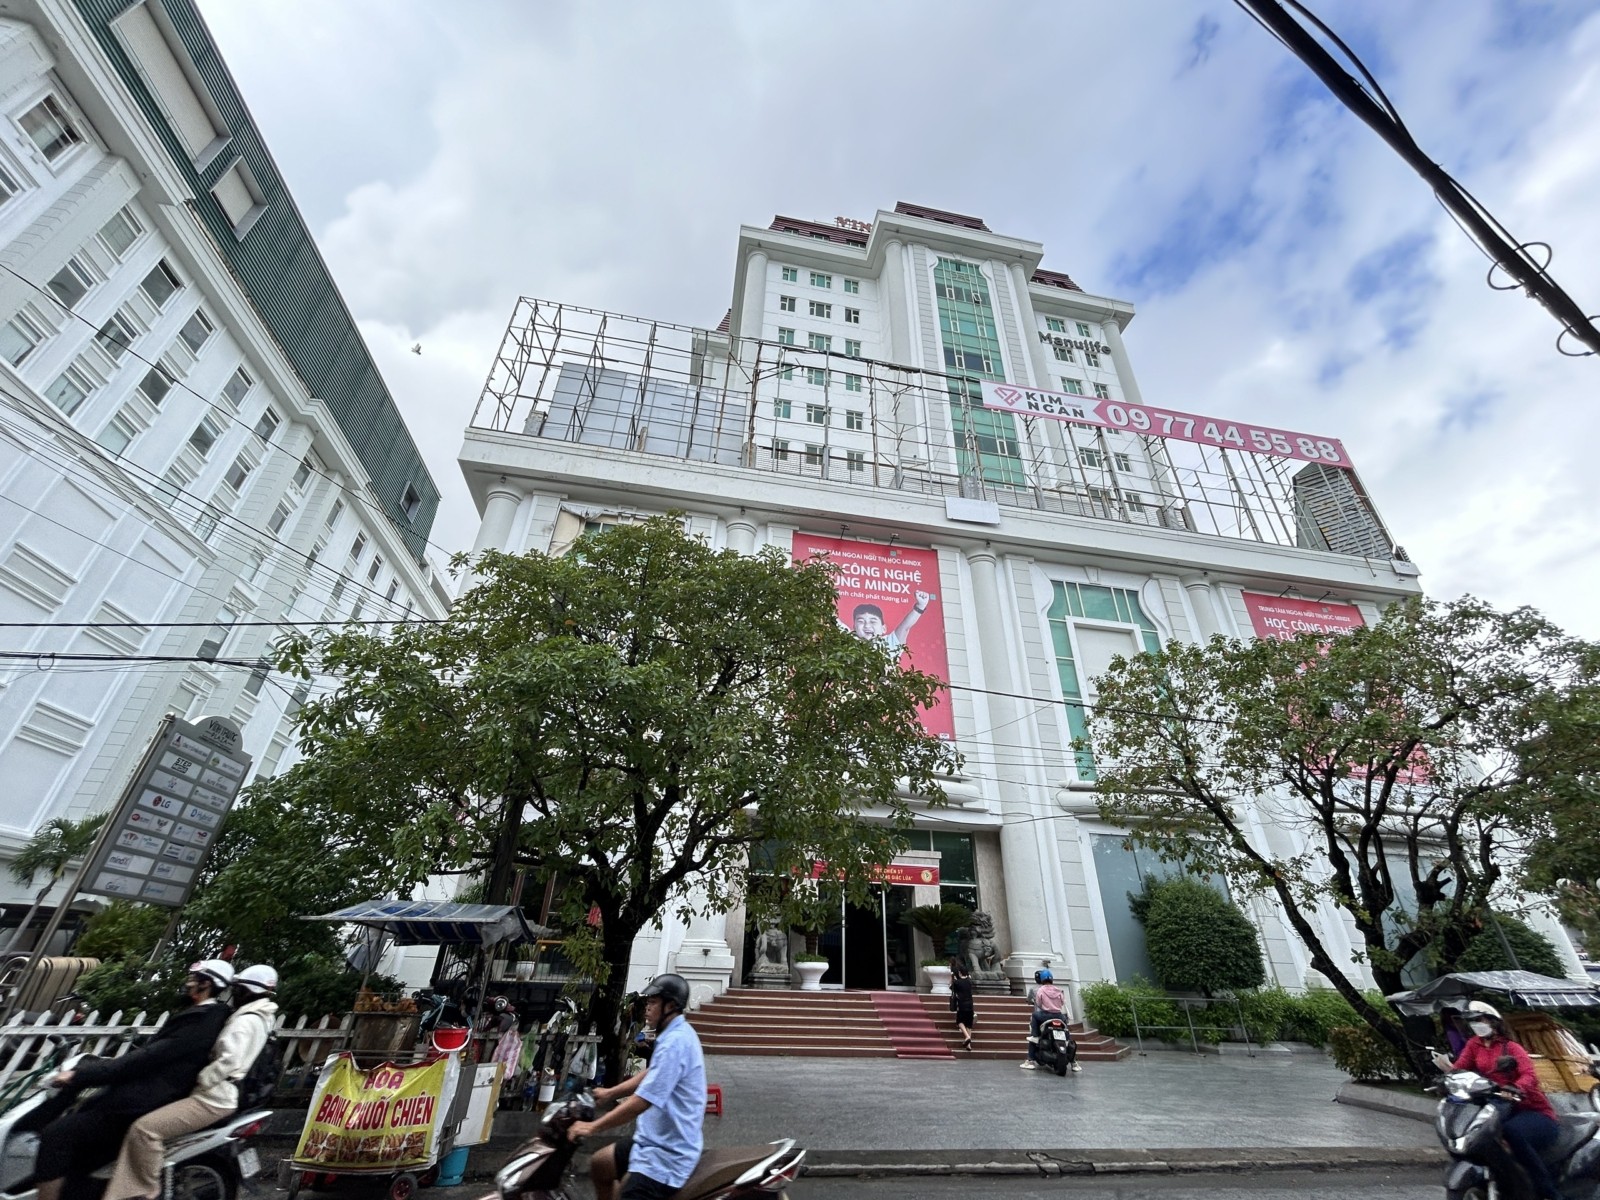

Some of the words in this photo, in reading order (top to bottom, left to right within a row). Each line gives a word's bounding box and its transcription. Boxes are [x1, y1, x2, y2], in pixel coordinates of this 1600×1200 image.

[1038, 331, 1111, 355] Manulife
[1025, 391, 1063, 405] KIM
[1027, 401, 1085, 418] NGAN
[842, 562, 880, 578] CÔNG
[884, 569, 922, 586] NGHỆ
[864, 579, 911, 595] MINDX
[1264, 616, 1290, 631] HỌC
[1291, 619, 1323, 633] CÔNG
[176, 757, 193, 767] STEP
[160, 799, 171, 809] LG
[315, 1087, 351, 1128] BÁNH
[390, 1091, 435, 1128] CHIÊN
